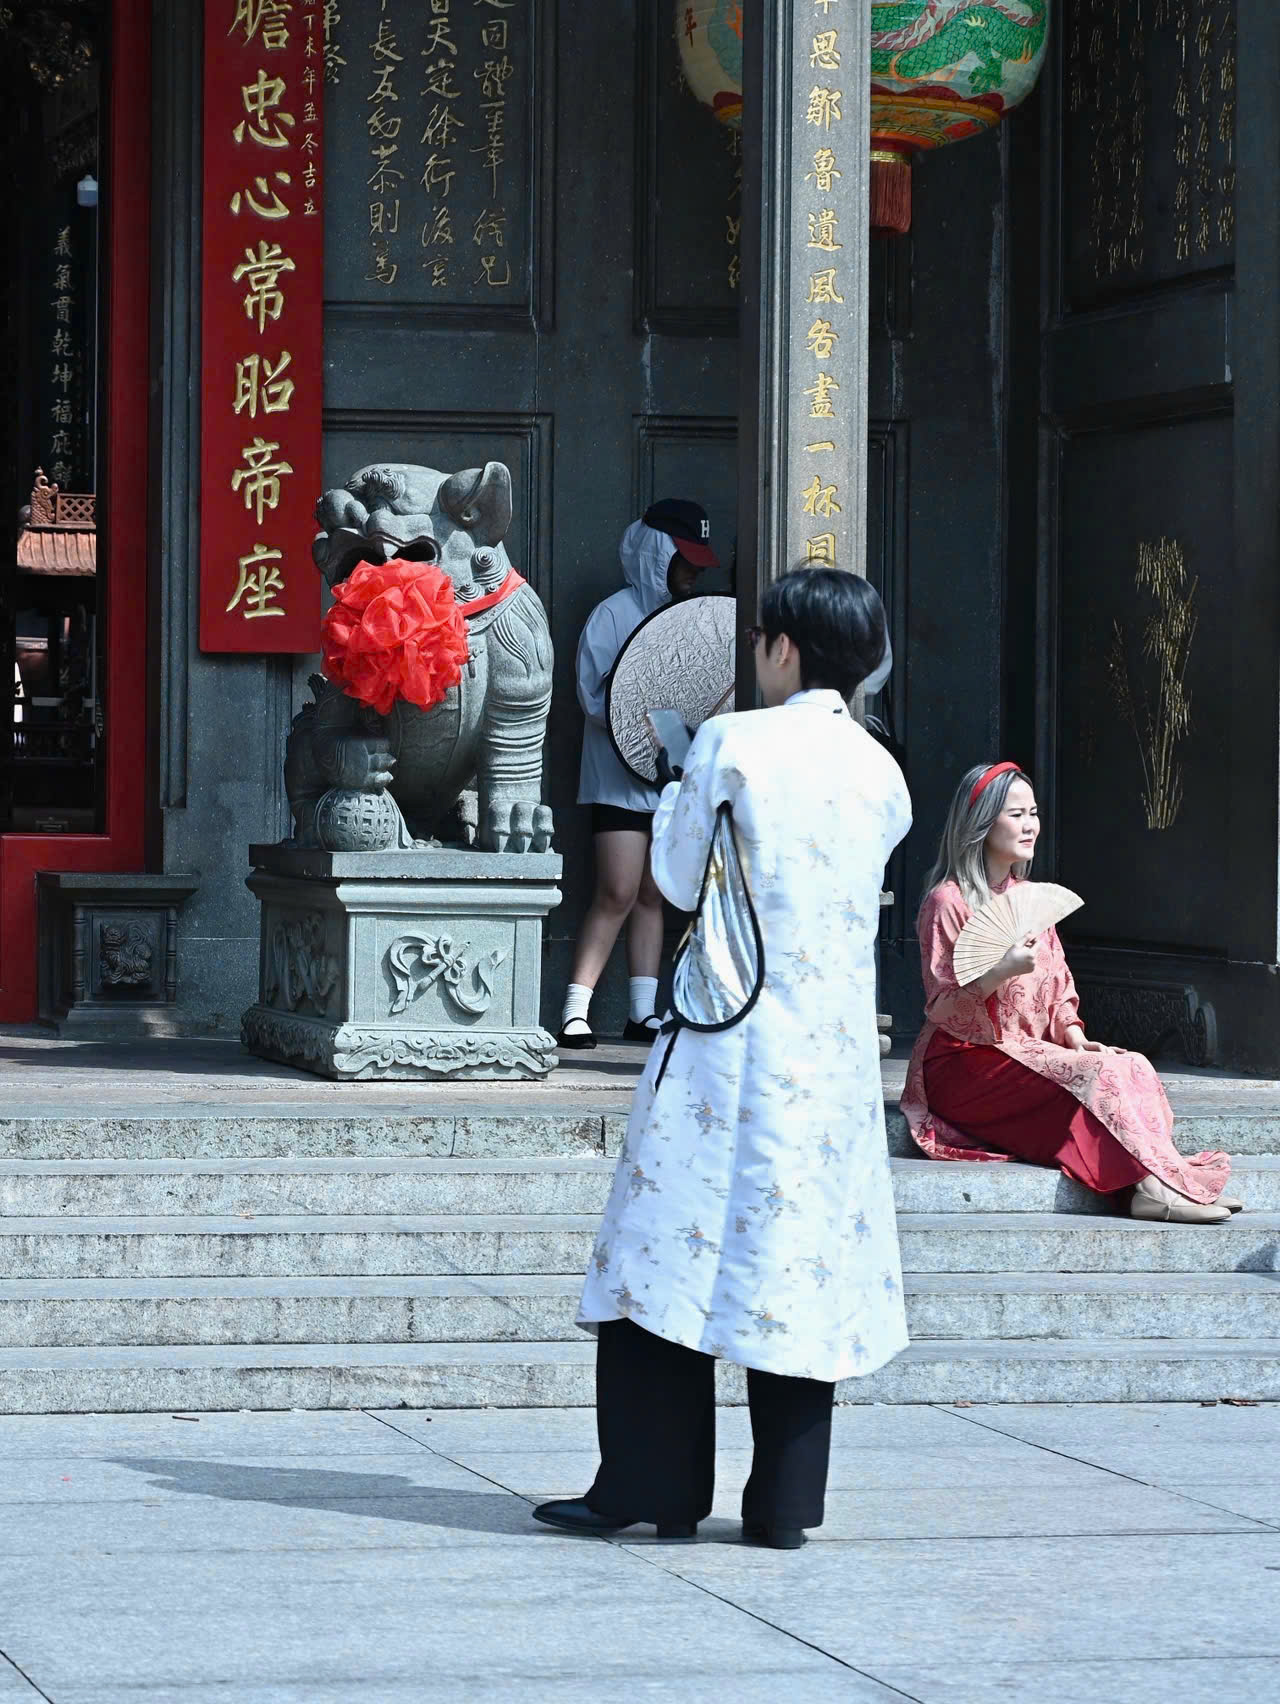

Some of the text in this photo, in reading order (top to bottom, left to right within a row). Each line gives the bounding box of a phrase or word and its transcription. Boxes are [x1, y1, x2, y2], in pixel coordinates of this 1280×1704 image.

[301, 0, 319, 216] 丁未年孟冬吉立
[701, 519, 710, 538] H
